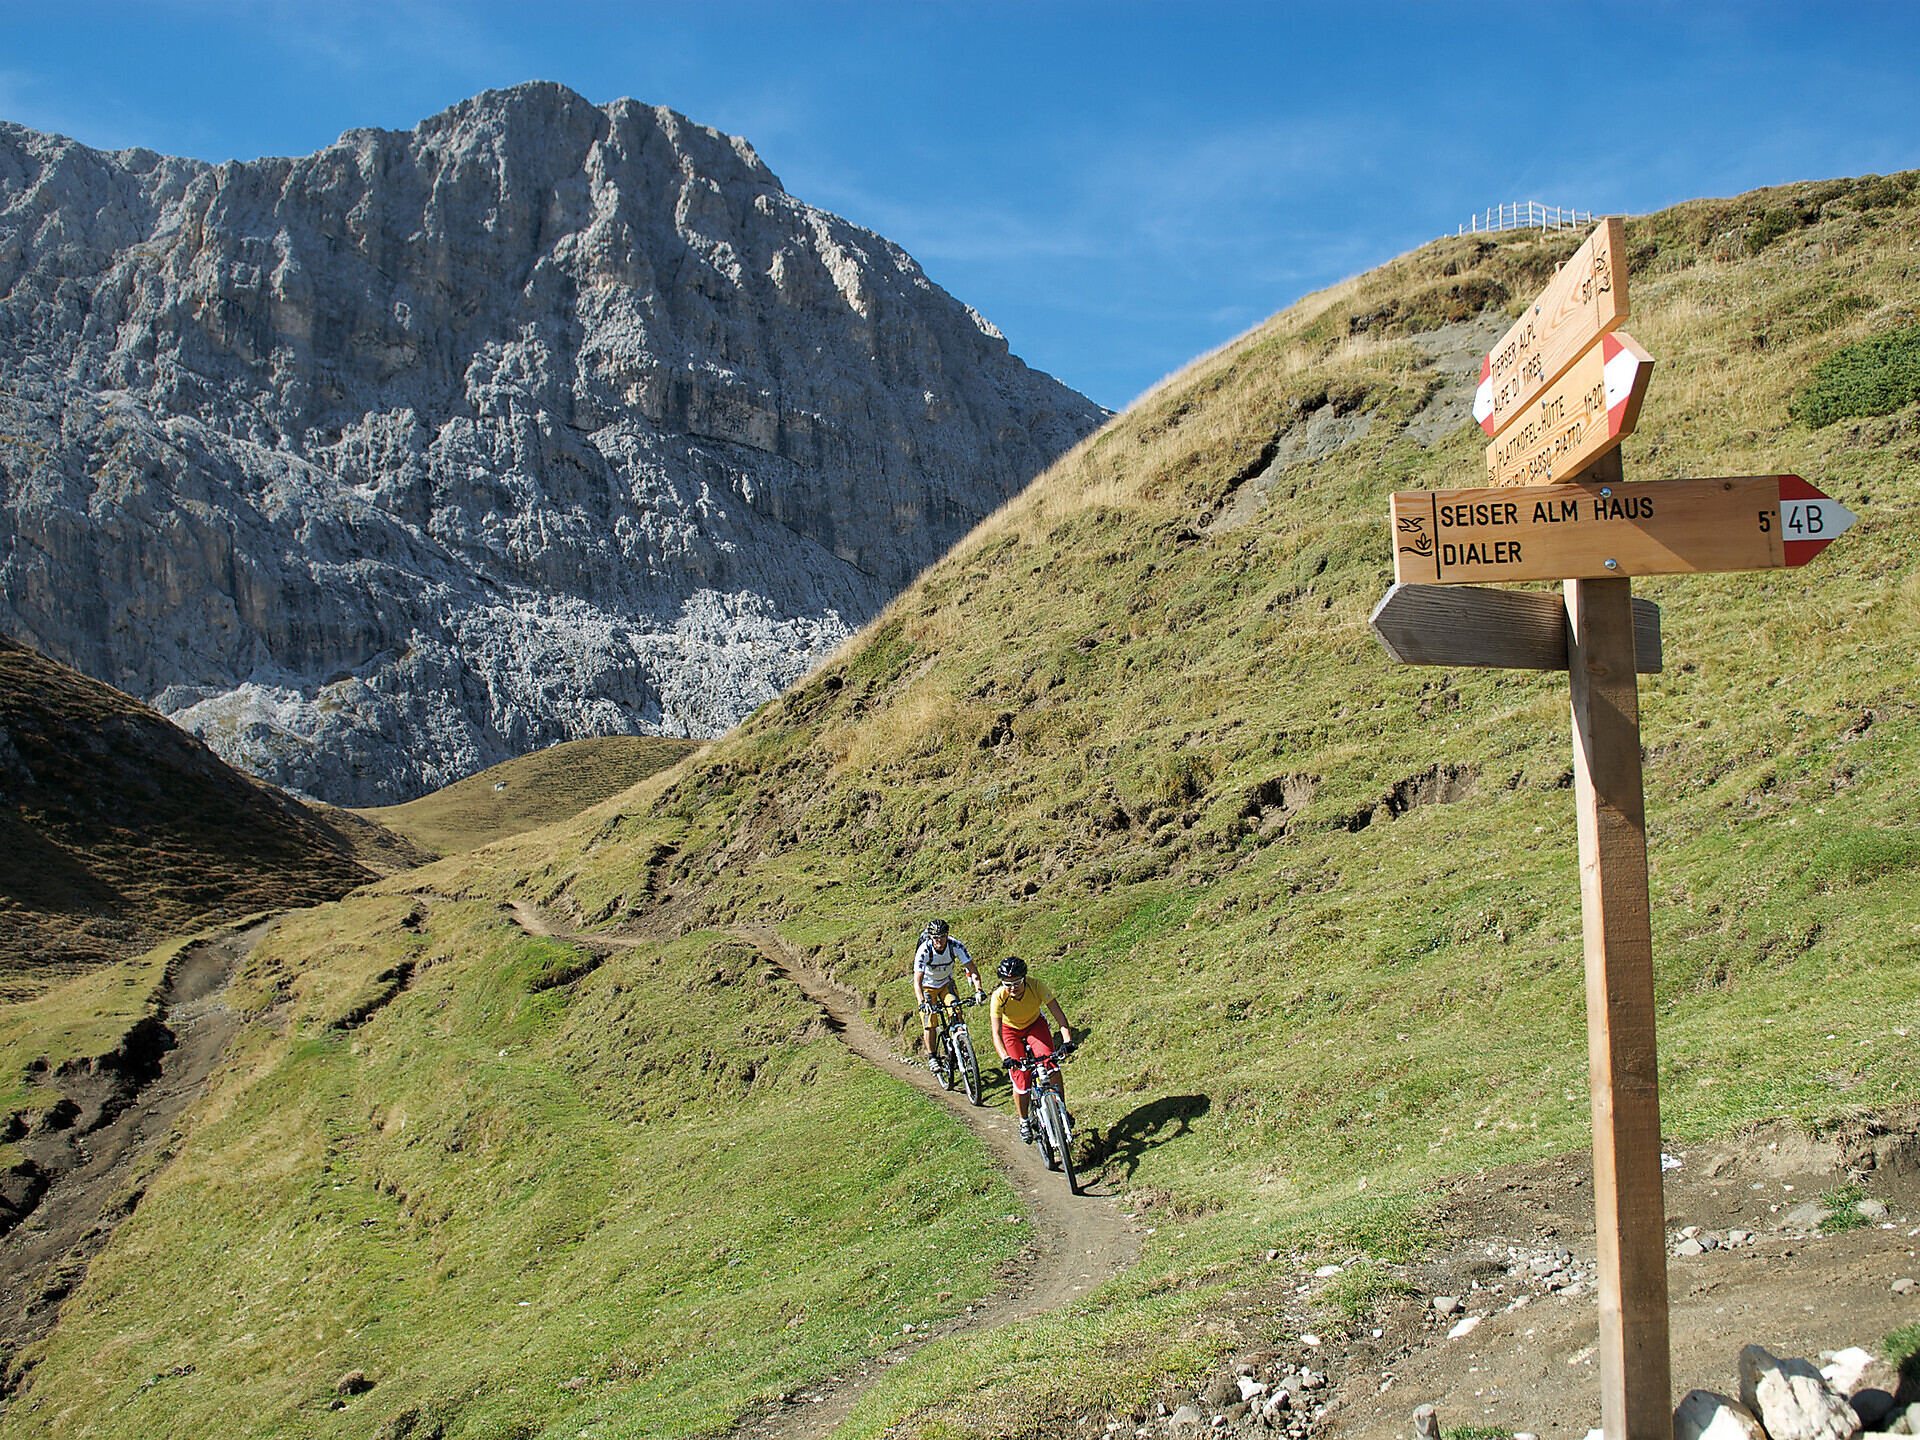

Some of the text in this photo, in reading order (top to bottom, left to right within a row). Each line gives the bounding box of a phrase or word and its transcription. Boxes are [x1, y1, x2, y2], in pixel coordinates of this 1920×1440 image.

[1512, 374, 1520, 397] DI
[1522, 353, 1542, 386] TIRES
[1529, 447, 1552, 481] SASSO
[1555, 423, 1583, 459] PIATTO
[1440, 497, 1654, 528] SEISER ALM HAUS
[1788, 504, 1824, 535] 4B
[1443, 541, 1522, 567] DIALER
